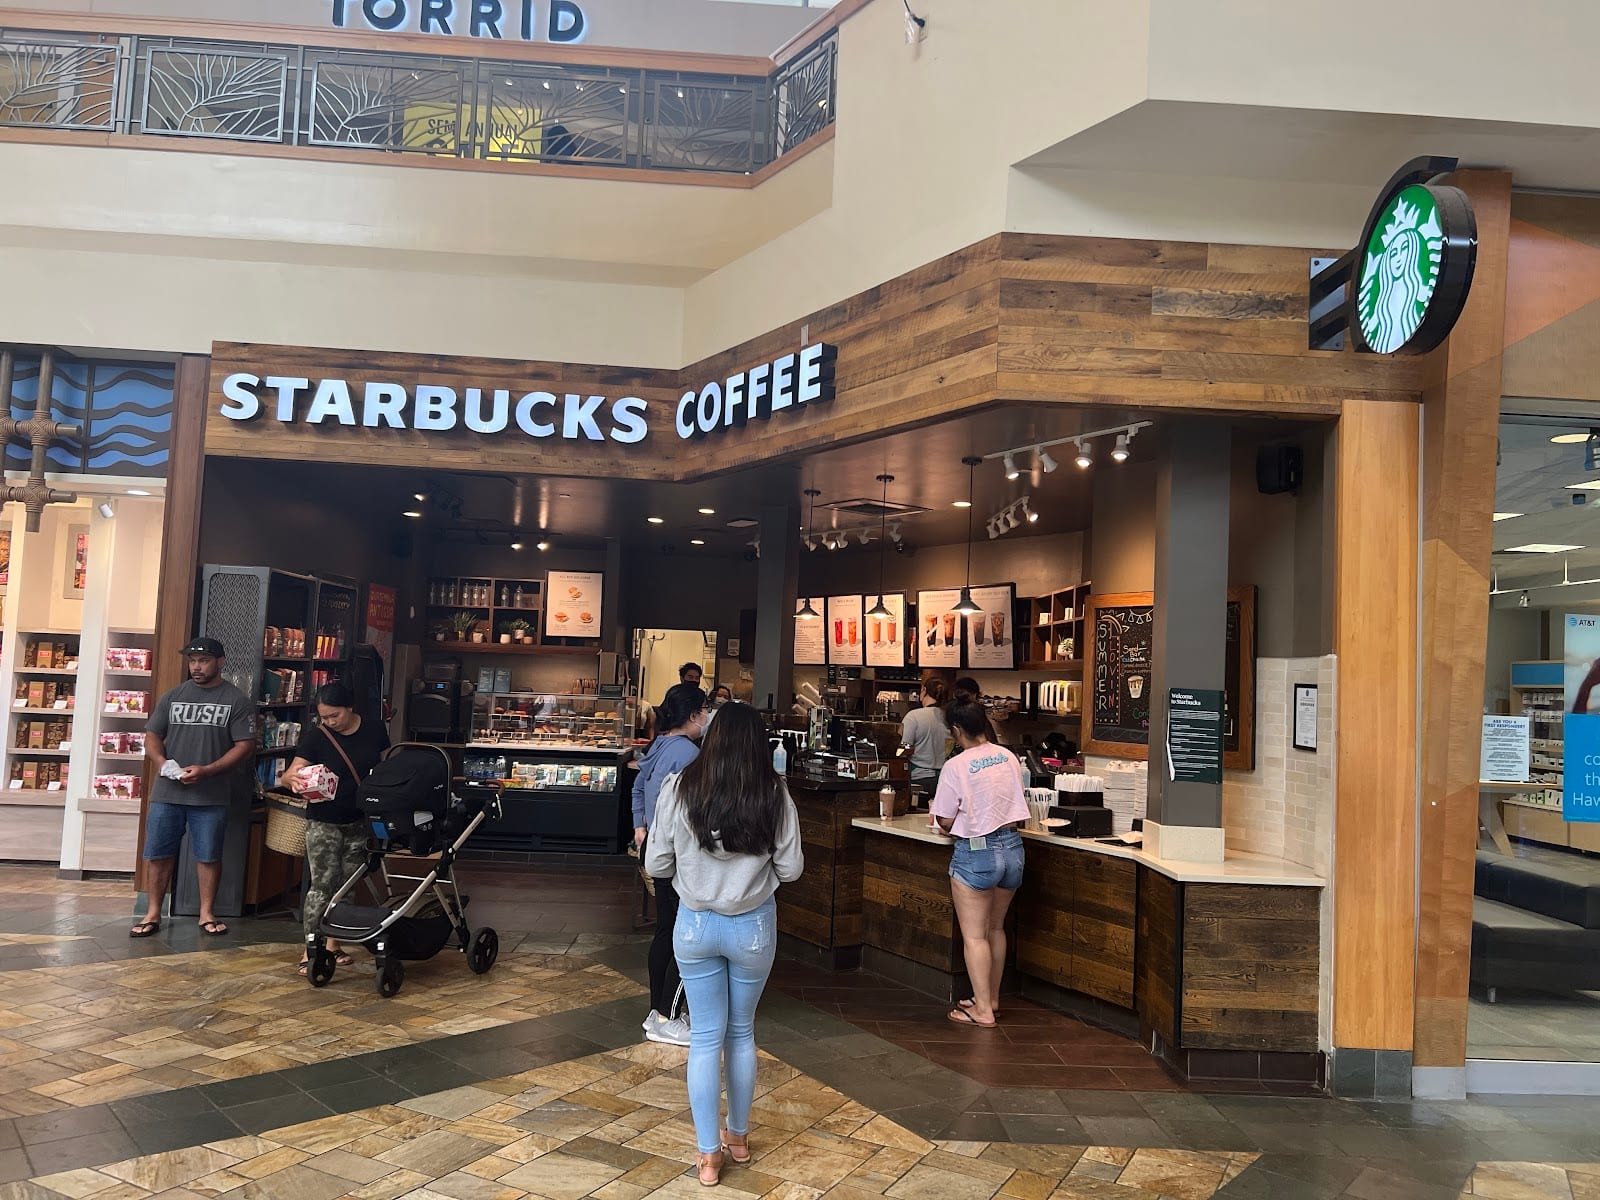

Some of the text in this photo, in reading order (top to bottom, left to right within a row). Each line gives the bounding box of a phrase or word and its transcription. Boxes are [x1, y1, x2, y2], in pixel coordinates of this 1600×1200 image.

[427, 118, 458, 136] SEM
[219, 342, 824, 444] STARBUCKS COFFEE
[1098, 623, 1108, 710] SUMMER
[1171, 692, 1194, 700] Welcome
[171, 704, 229, 725] RUSH
